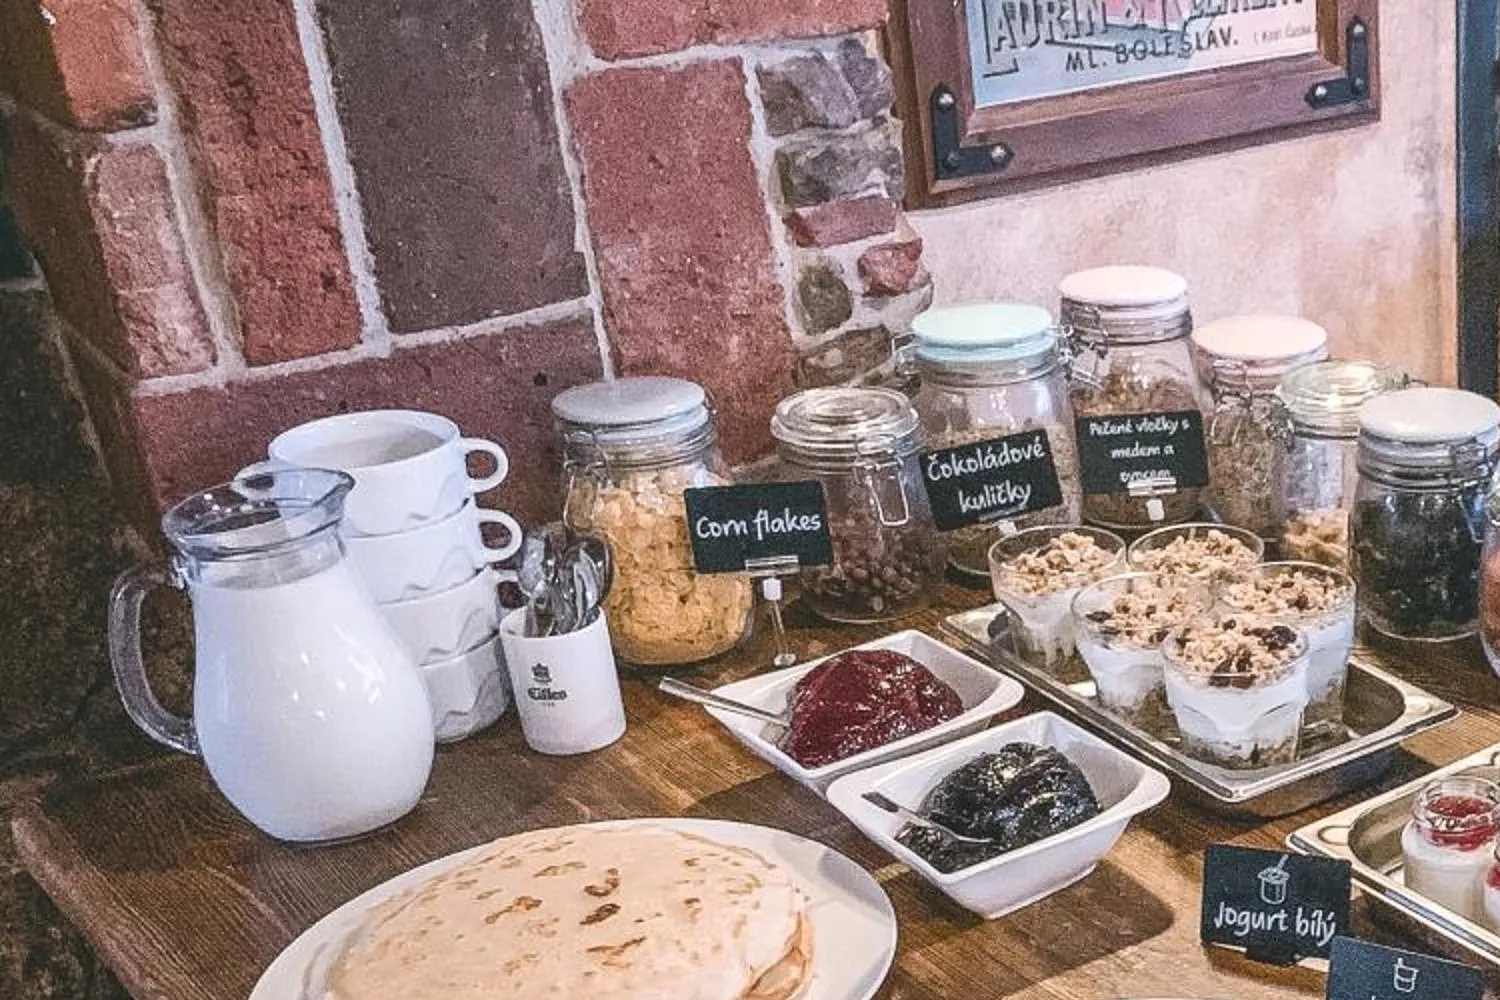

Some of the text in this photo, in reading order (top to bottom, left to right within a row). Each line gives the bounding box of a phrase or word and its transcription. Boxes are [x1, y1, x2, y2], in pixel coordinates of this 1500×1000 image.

[1066, 50, 1107, 72] ML.
[1115, 26, 1238, 64] BOLESLAV.
[1136, 416, 1179, 435] vločky
[1181, 419, 1191, 430] s
[928, 436, 1045, 480] Čokoládové
[1111, 441, 1175, 459] medem a
[958, 480, 1031, 513] kuličky
[696, 507, 821, 540] Corn flakes
[1214, 901, 1336, 947] Jogurt bílý
